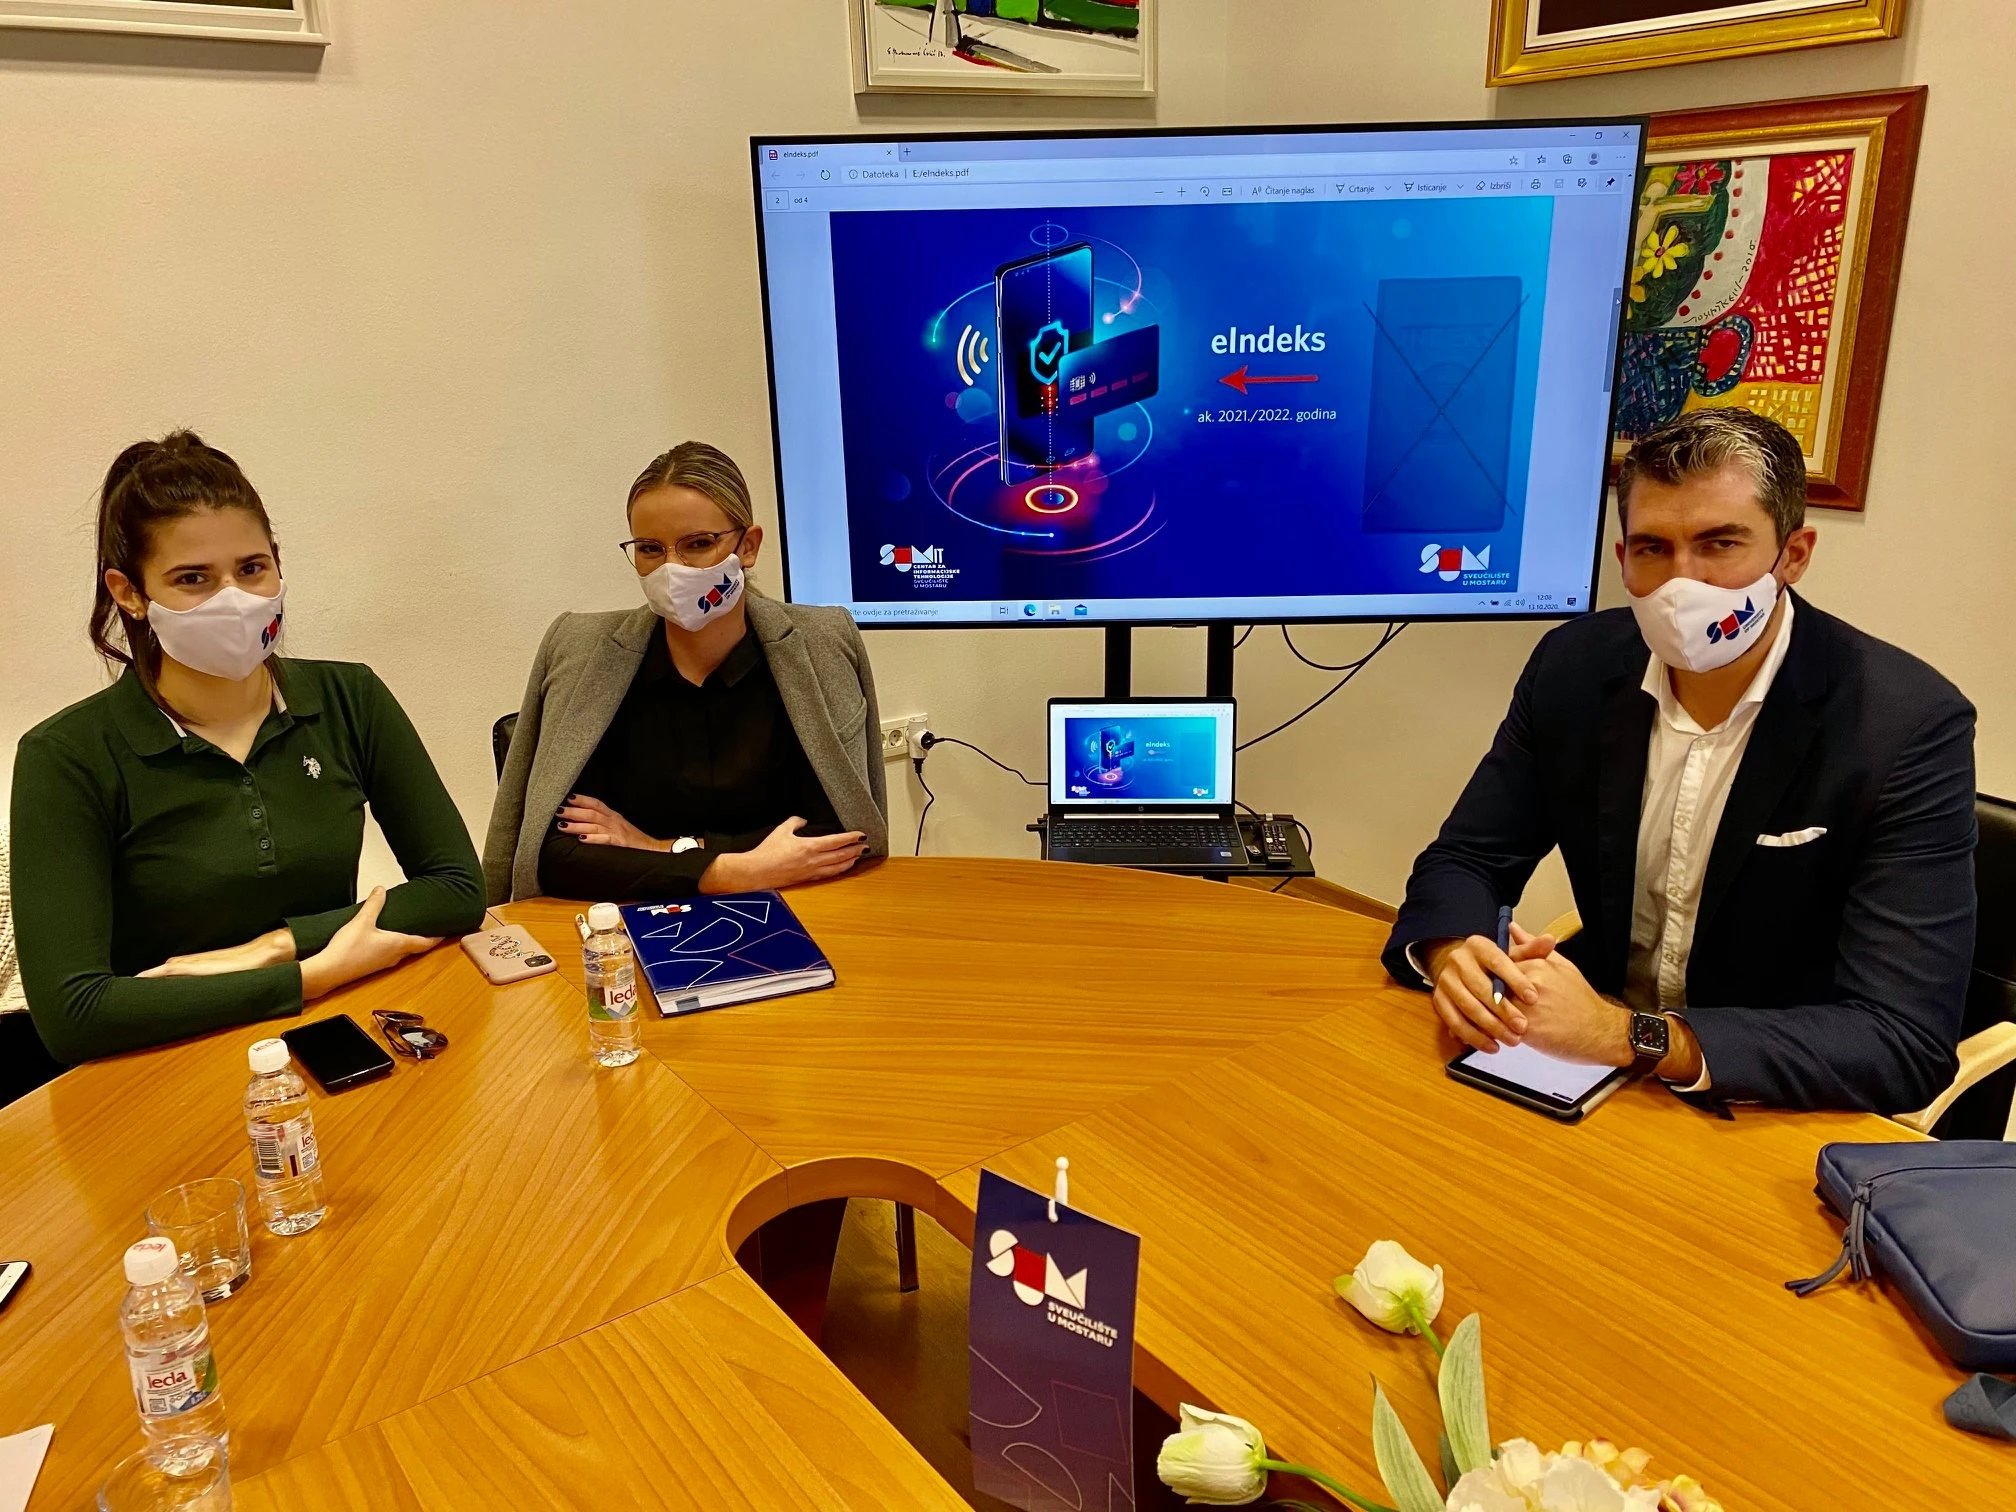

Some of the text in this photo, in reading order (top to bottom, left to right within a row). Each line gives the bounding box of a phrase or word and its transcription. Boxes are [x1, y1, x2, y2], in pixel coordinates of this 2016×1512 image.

[862, 170, 899, 179] Datoteka
[1265, 185, 1315, 197] Čitanje naglas
[1348, 184, 1375, 194] Crtanje
[1417, 183, 1447, 193] Isticanje
[794, 196, 803, 204] od
[1211, 324, 1326, 354] eIndeks
[1197, 408, 1337, 423] ak. 2021./2022. godina
[862, 608, 882, 617] ovdje
[893, 607, 939, 617] pretraživanje
[1047, 1300, 1118, 1339] SVEUČILIŠTE
[1047, 1312, 1114, 1348] U MOSTARU
[147, 1371, 187, 1389] leda
